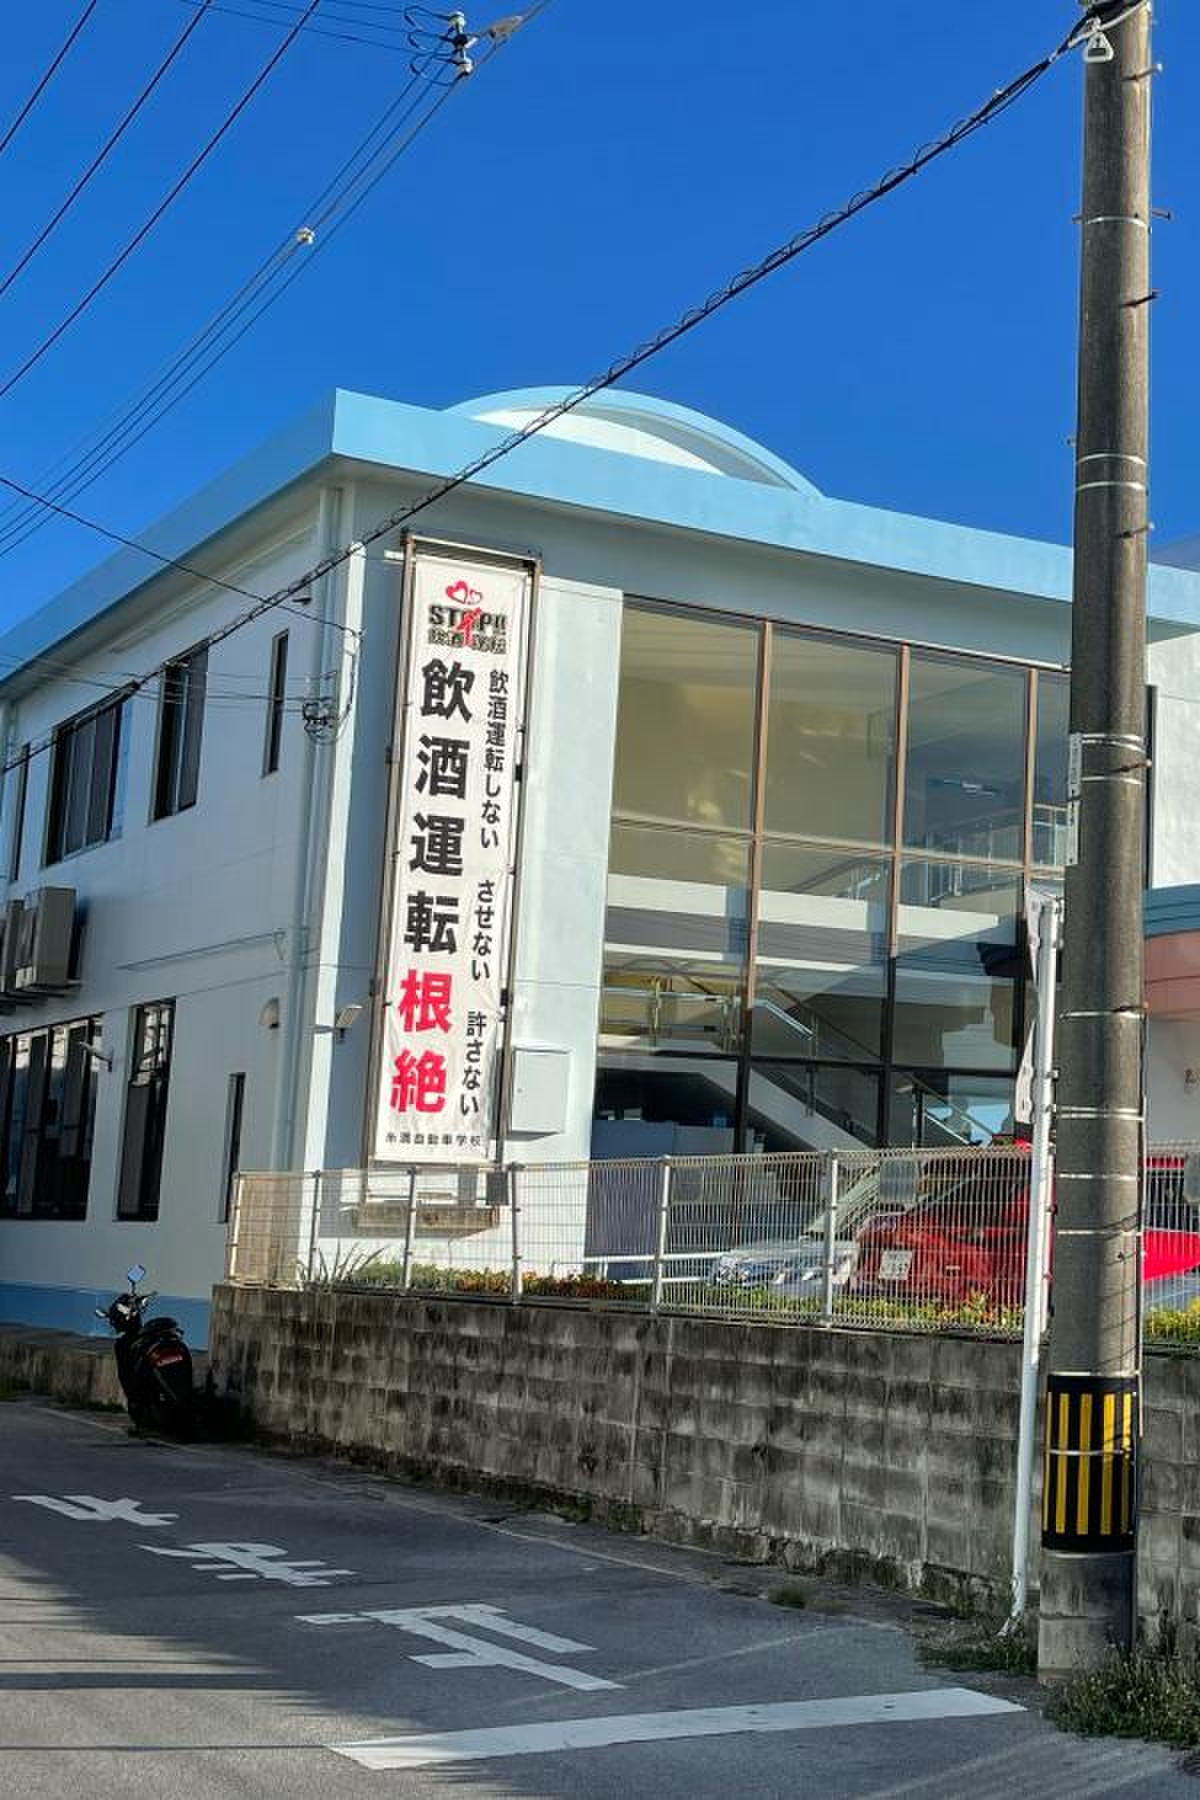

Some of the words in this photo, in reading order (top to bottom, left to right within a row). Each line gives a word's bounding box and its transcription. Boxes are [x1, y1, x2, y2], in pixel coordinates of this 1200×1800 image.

[480, 669, 509, 849] 飲酒運転しない
[389, 658, 476, 1114] 飲酒運転根絶
[472, 879, 496, 981] させない
[460, 1010, 488, 1116] 許さない
